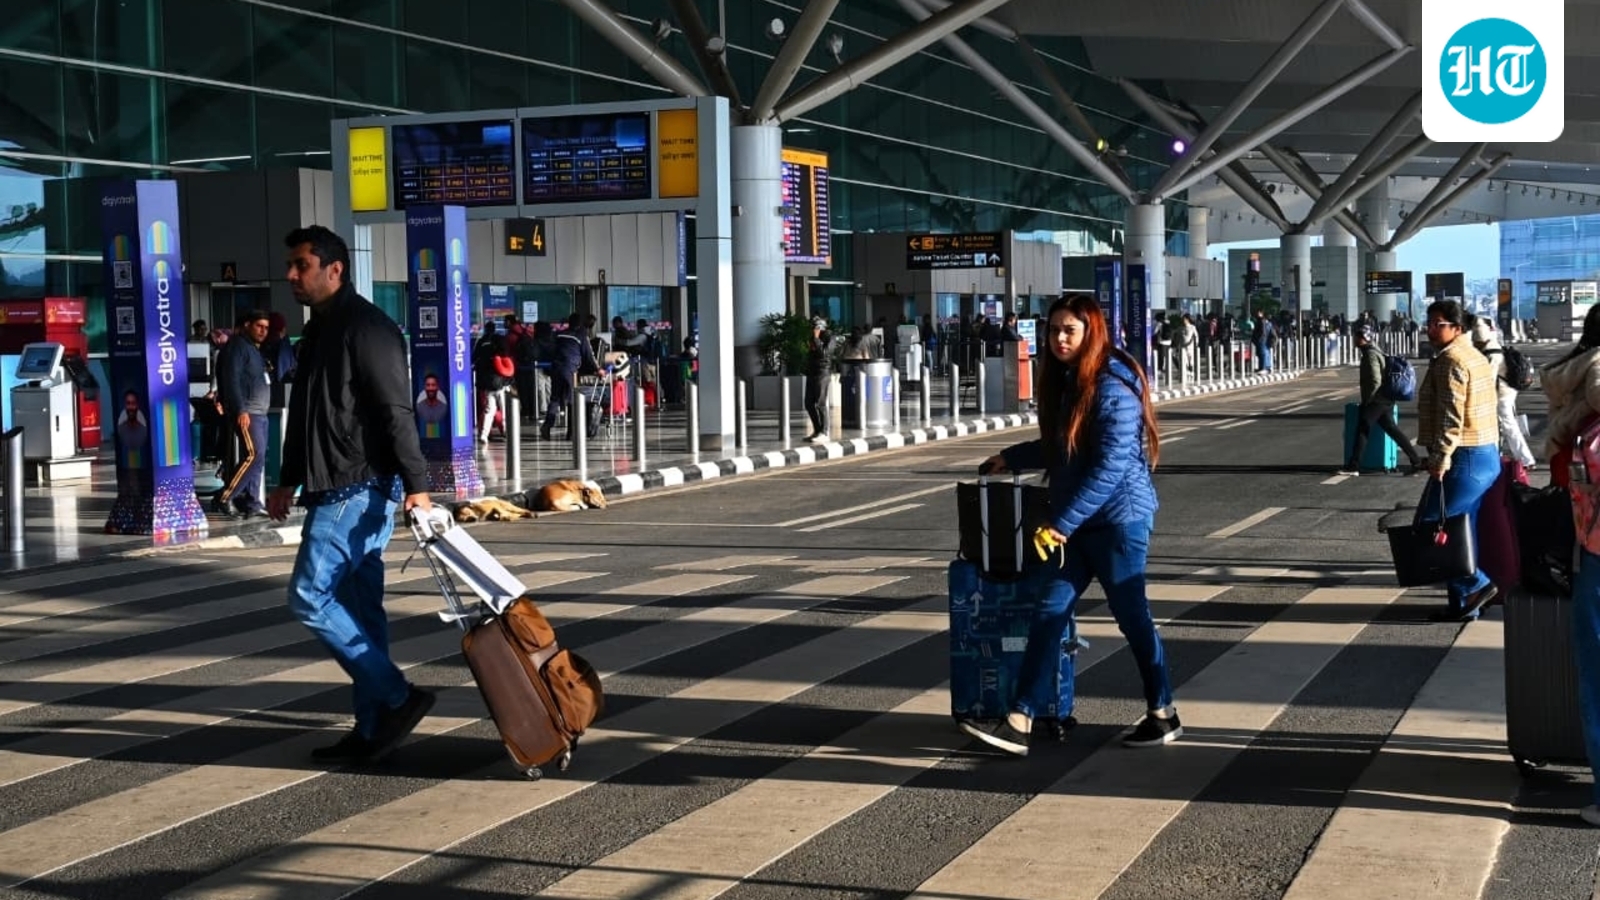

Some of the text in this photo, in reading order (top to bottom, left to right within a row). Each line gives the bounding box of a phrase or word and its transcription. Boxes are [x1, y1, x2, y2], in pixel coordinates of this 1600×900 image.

[661, 138, 677, 146] WAIT
[352, 154, 383, 163] WAIT TIME
[532, 225, 543, 250] 4
[951, 237, 959, 248] 4
[224, 265, 235, 279] A
[156, 278, 178, 386] digiyatra
[454, 284, 466, 371] digiyatra
